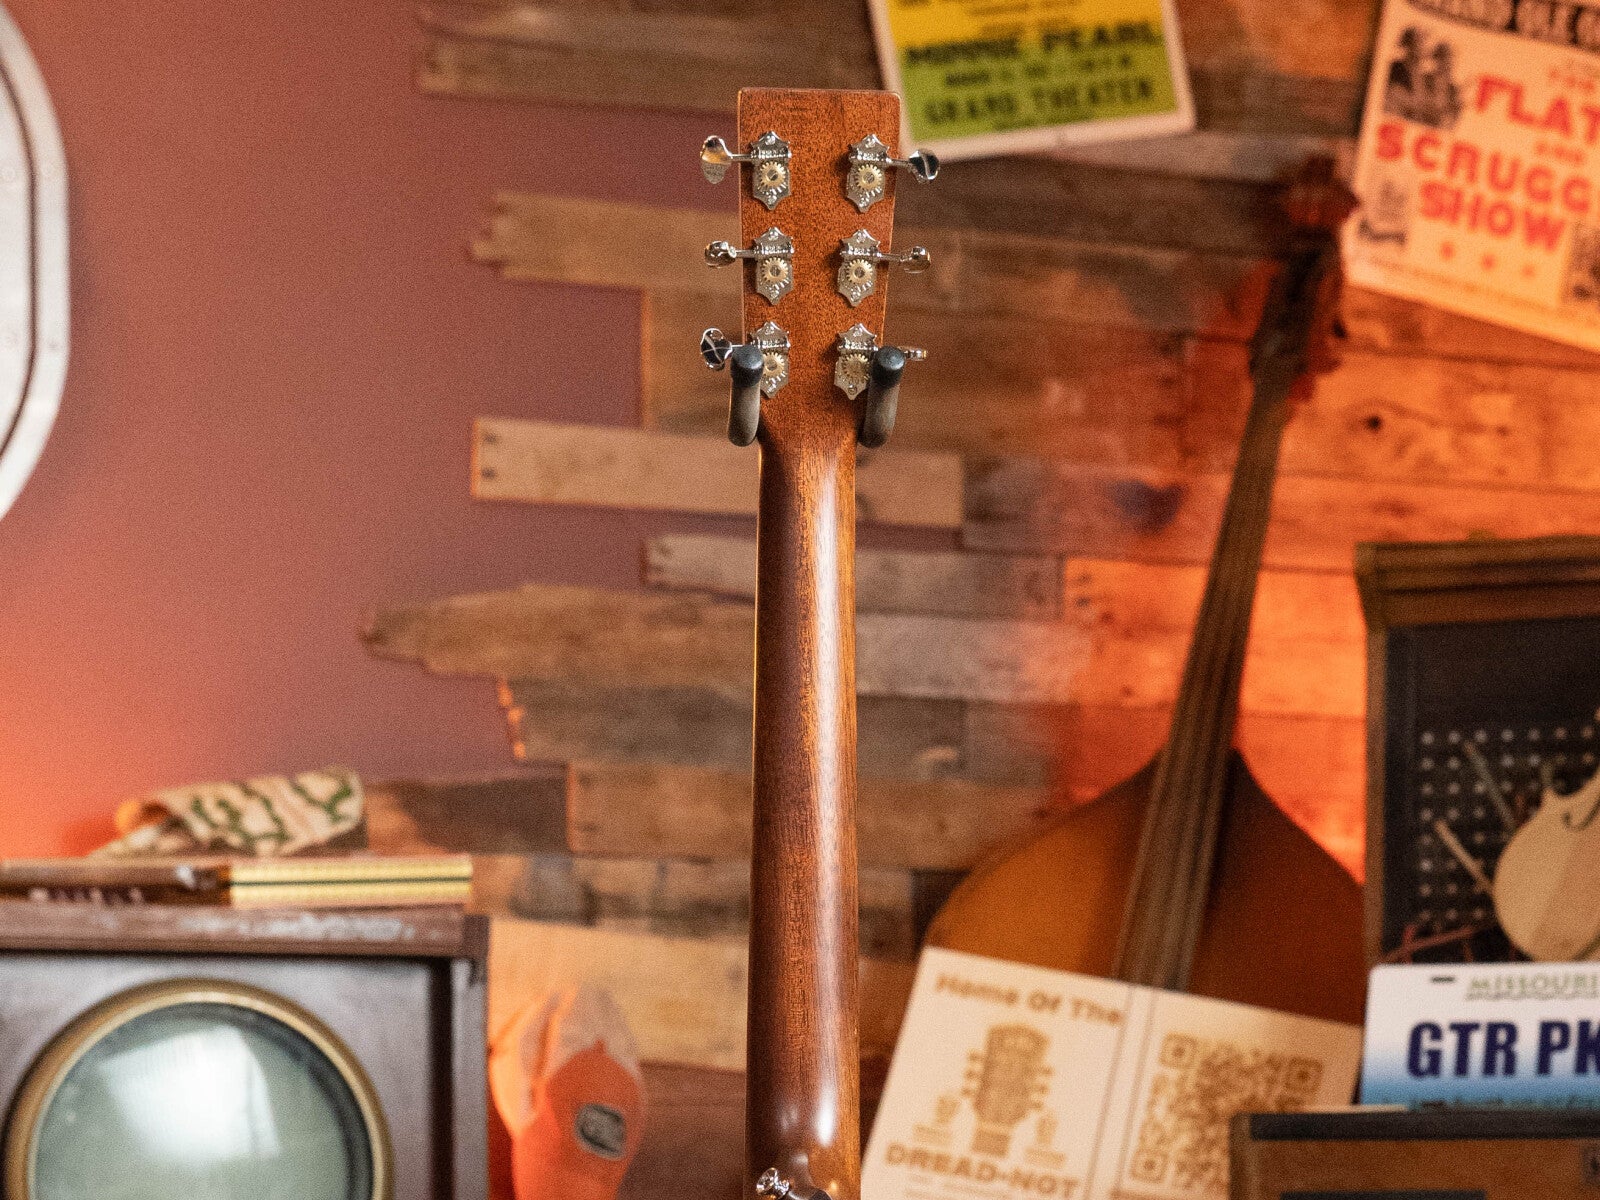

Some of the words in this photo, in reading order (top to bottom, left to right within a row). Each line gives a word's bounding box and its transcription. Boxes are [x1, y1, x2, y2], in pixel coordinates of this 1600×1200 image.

[1377, 121, 1597, 214] SCRUGG
[1420, 181, 1566, 253] SHOW
[936, 973, 1019, 1007] Home
[1469, 973, 1600, 998] MISSOURI
[1406, 1020, 1518, 1079] GTR
[885, 1140, 1079, 1199] DREAD-NOT
